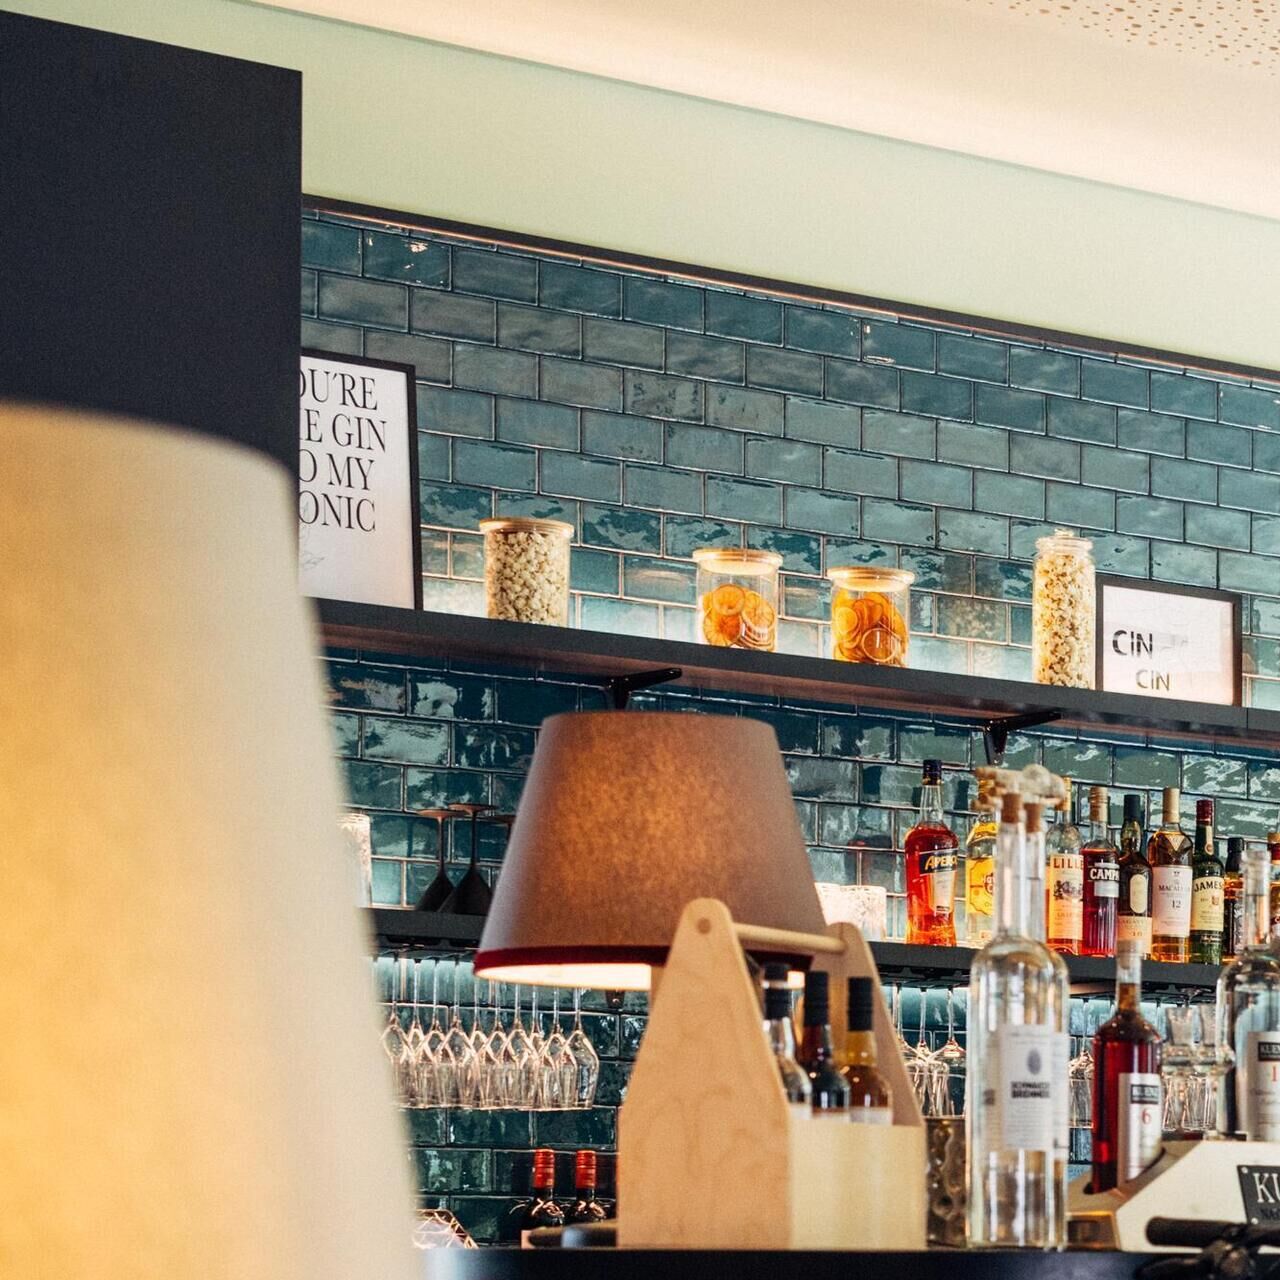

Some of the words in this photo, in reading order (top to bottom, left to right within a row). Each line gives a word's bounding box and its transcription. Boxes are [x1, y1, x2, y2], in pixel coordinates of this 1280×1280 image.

[299, 407, 322, 443] E
[331, 413, 387, 453] GIN
[326, 453, 374, 490] MY
[1111, 629, 1153, 657] CIN
[1135, 669, 1170, 691] CIN
